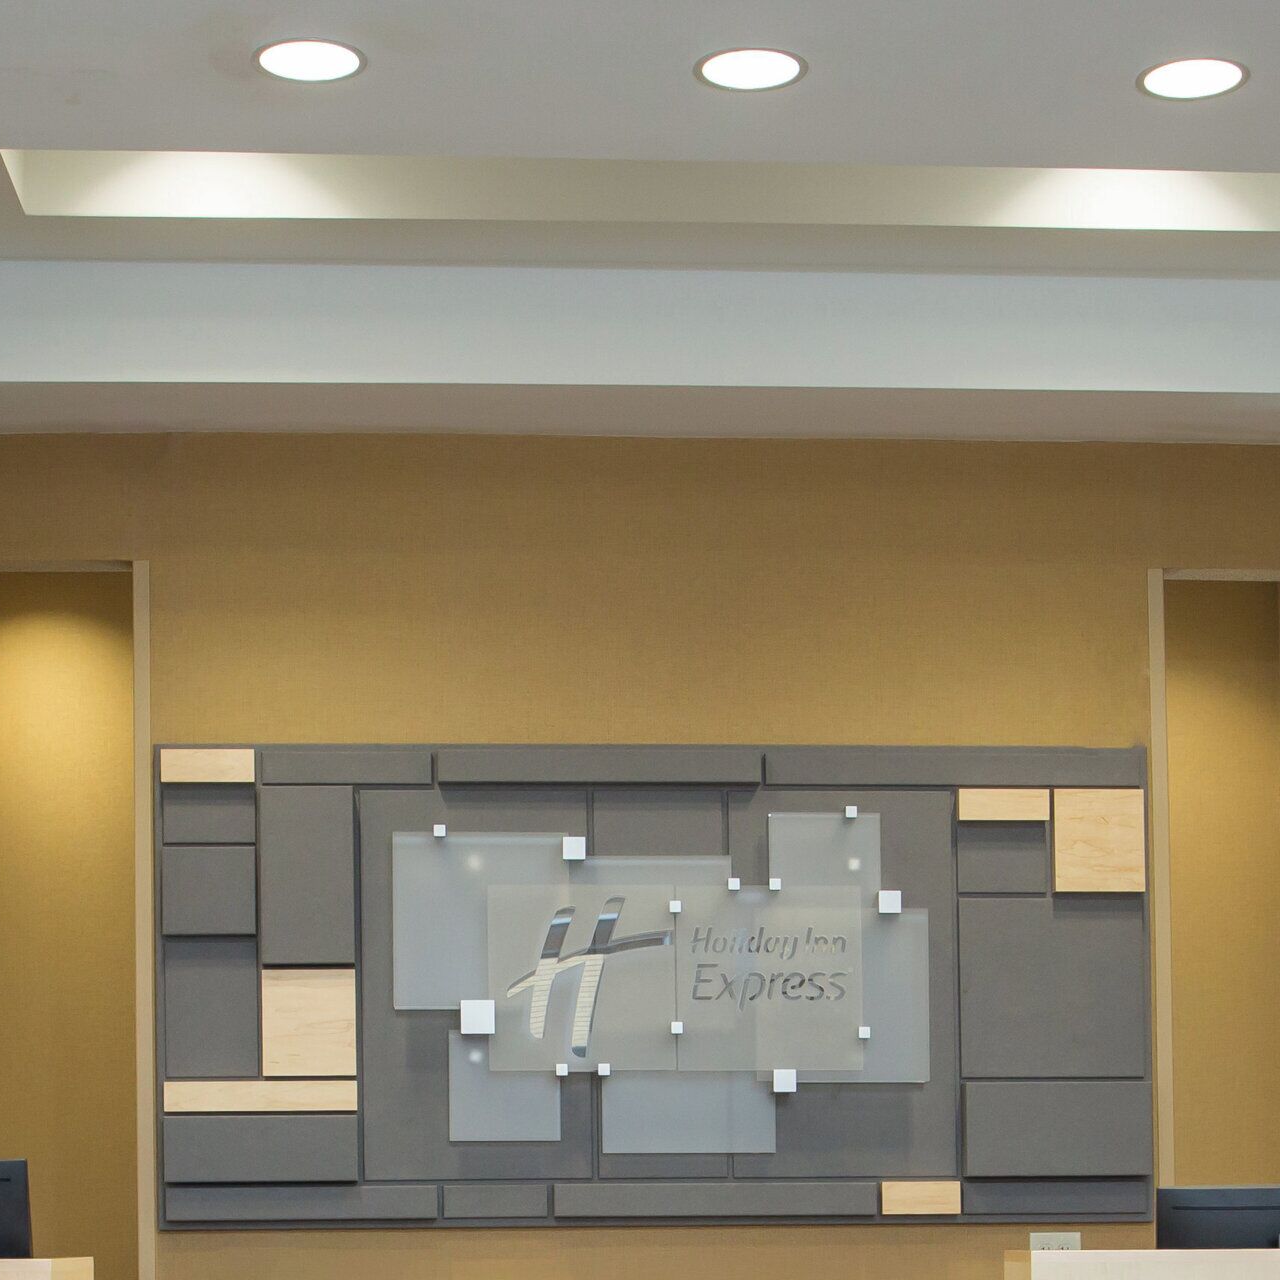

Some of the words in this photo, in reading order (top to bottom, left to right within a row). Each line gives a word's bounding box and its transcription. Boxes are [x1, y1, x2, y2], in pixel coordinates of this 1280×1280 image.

[690, 926, 800, 960] Holiday
[806, 927, 847, 953] Inn
[692, 963, 848, 1010] Express
